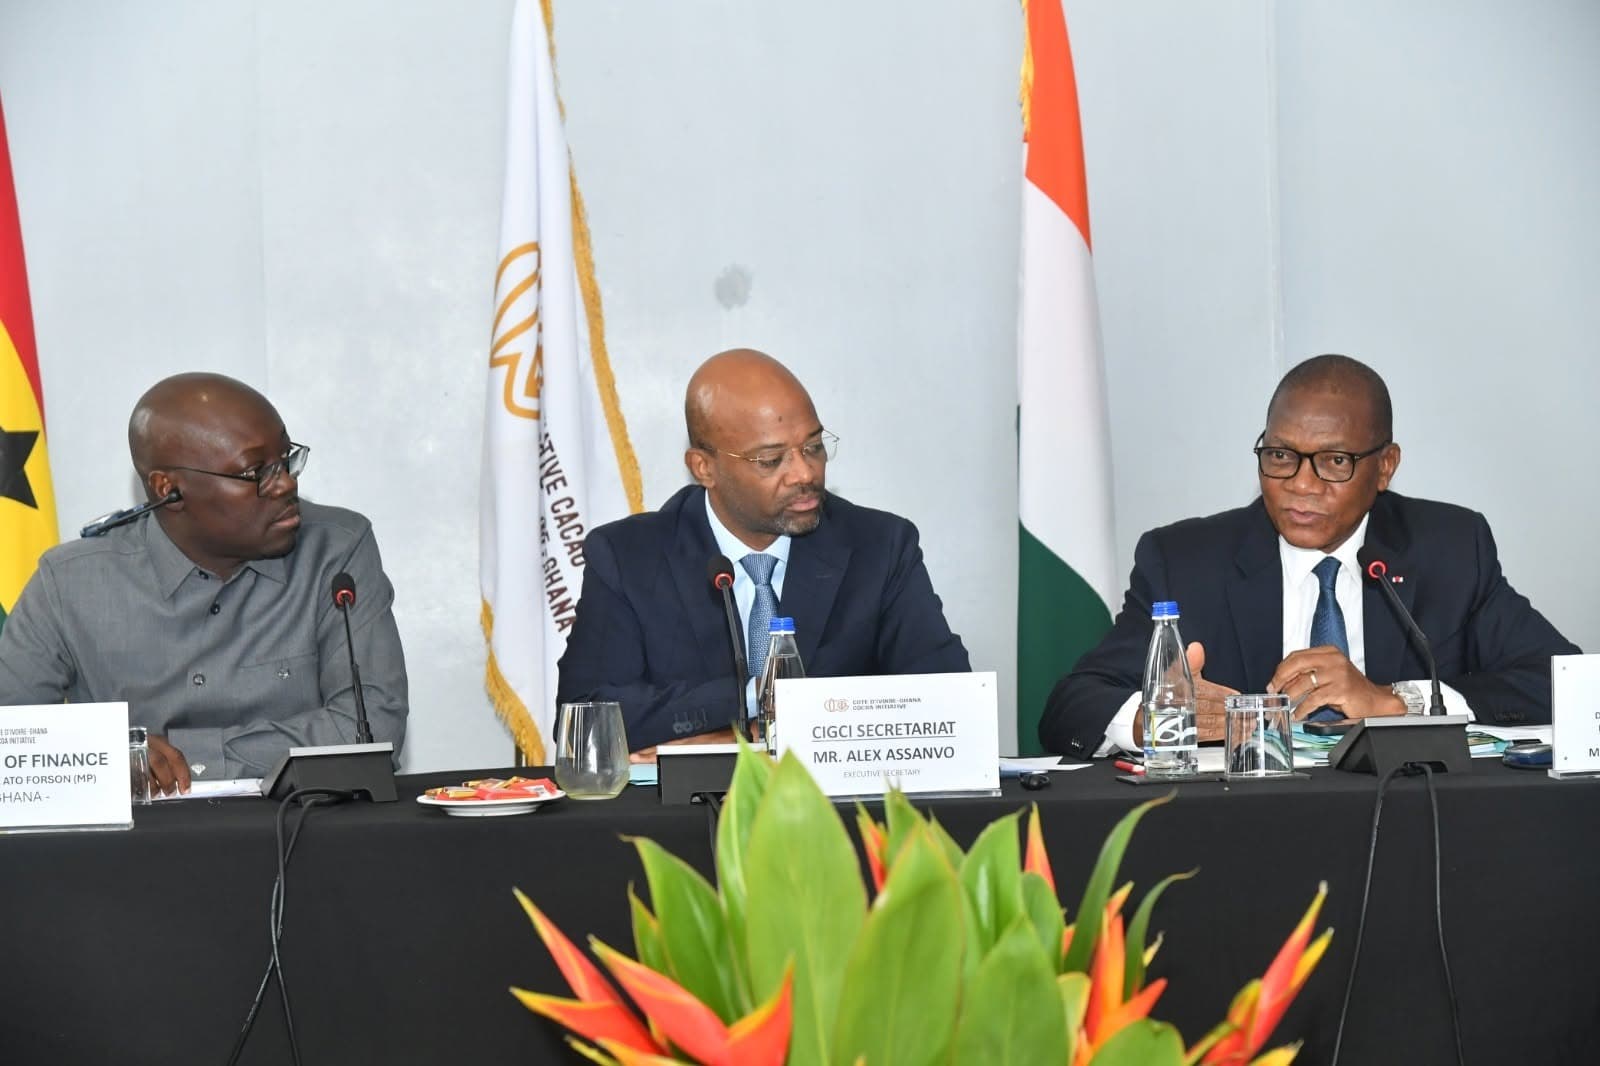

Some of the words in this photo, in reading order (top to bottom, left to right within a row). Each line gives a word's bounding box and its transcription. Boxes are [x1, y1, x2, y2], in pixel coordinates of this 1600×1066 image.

[542, 557, 577, 633] GHANA
[812, 725, 853, 739] CIGCI
[857, 721, 957, 738] SECRETARIAT
[4, 754, 28, 769] OF
[32, 752, 109, 768] FINANCE
[813, 751, 842, 764] MR.
[847, 749, 882, 763] ALEX
[886, 746, 955, 761] ASSANVO
[3, 776, 23, 785] ATO
[26, 774, 71, 785] FORSON
[73, 773, 97, 785] (MP)
[843, 769, 881, 778] EXECUTIVE
[0, 791, 42, 803] HANA
